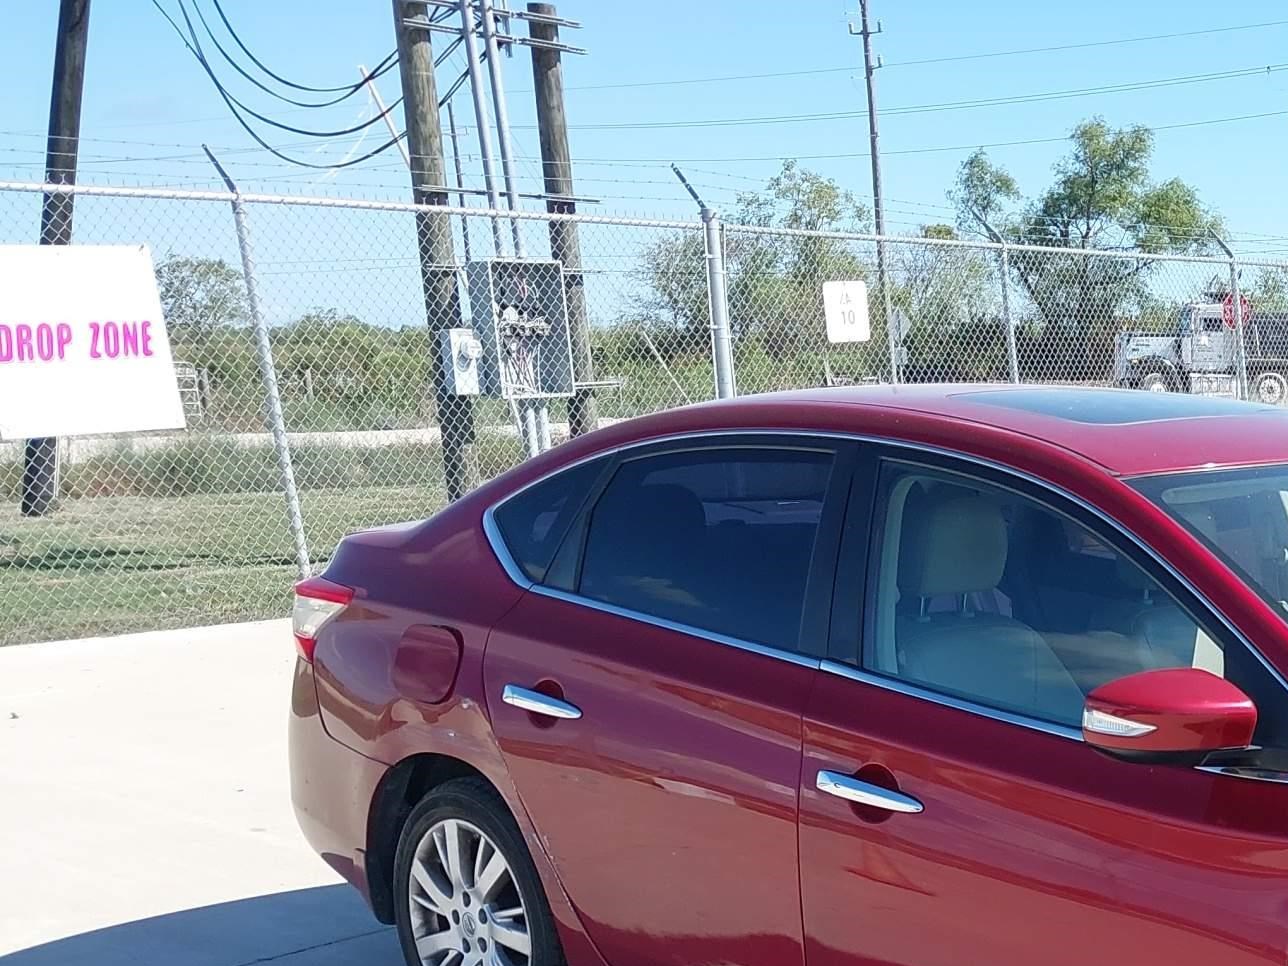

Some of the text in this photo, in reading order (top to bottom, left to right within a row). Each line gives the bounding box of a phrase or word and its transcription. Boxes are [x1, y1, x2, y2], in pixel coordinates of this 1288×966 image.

[841, 310, 855, 325] 10
[0, 321, 153, 362] DROP ZONE
